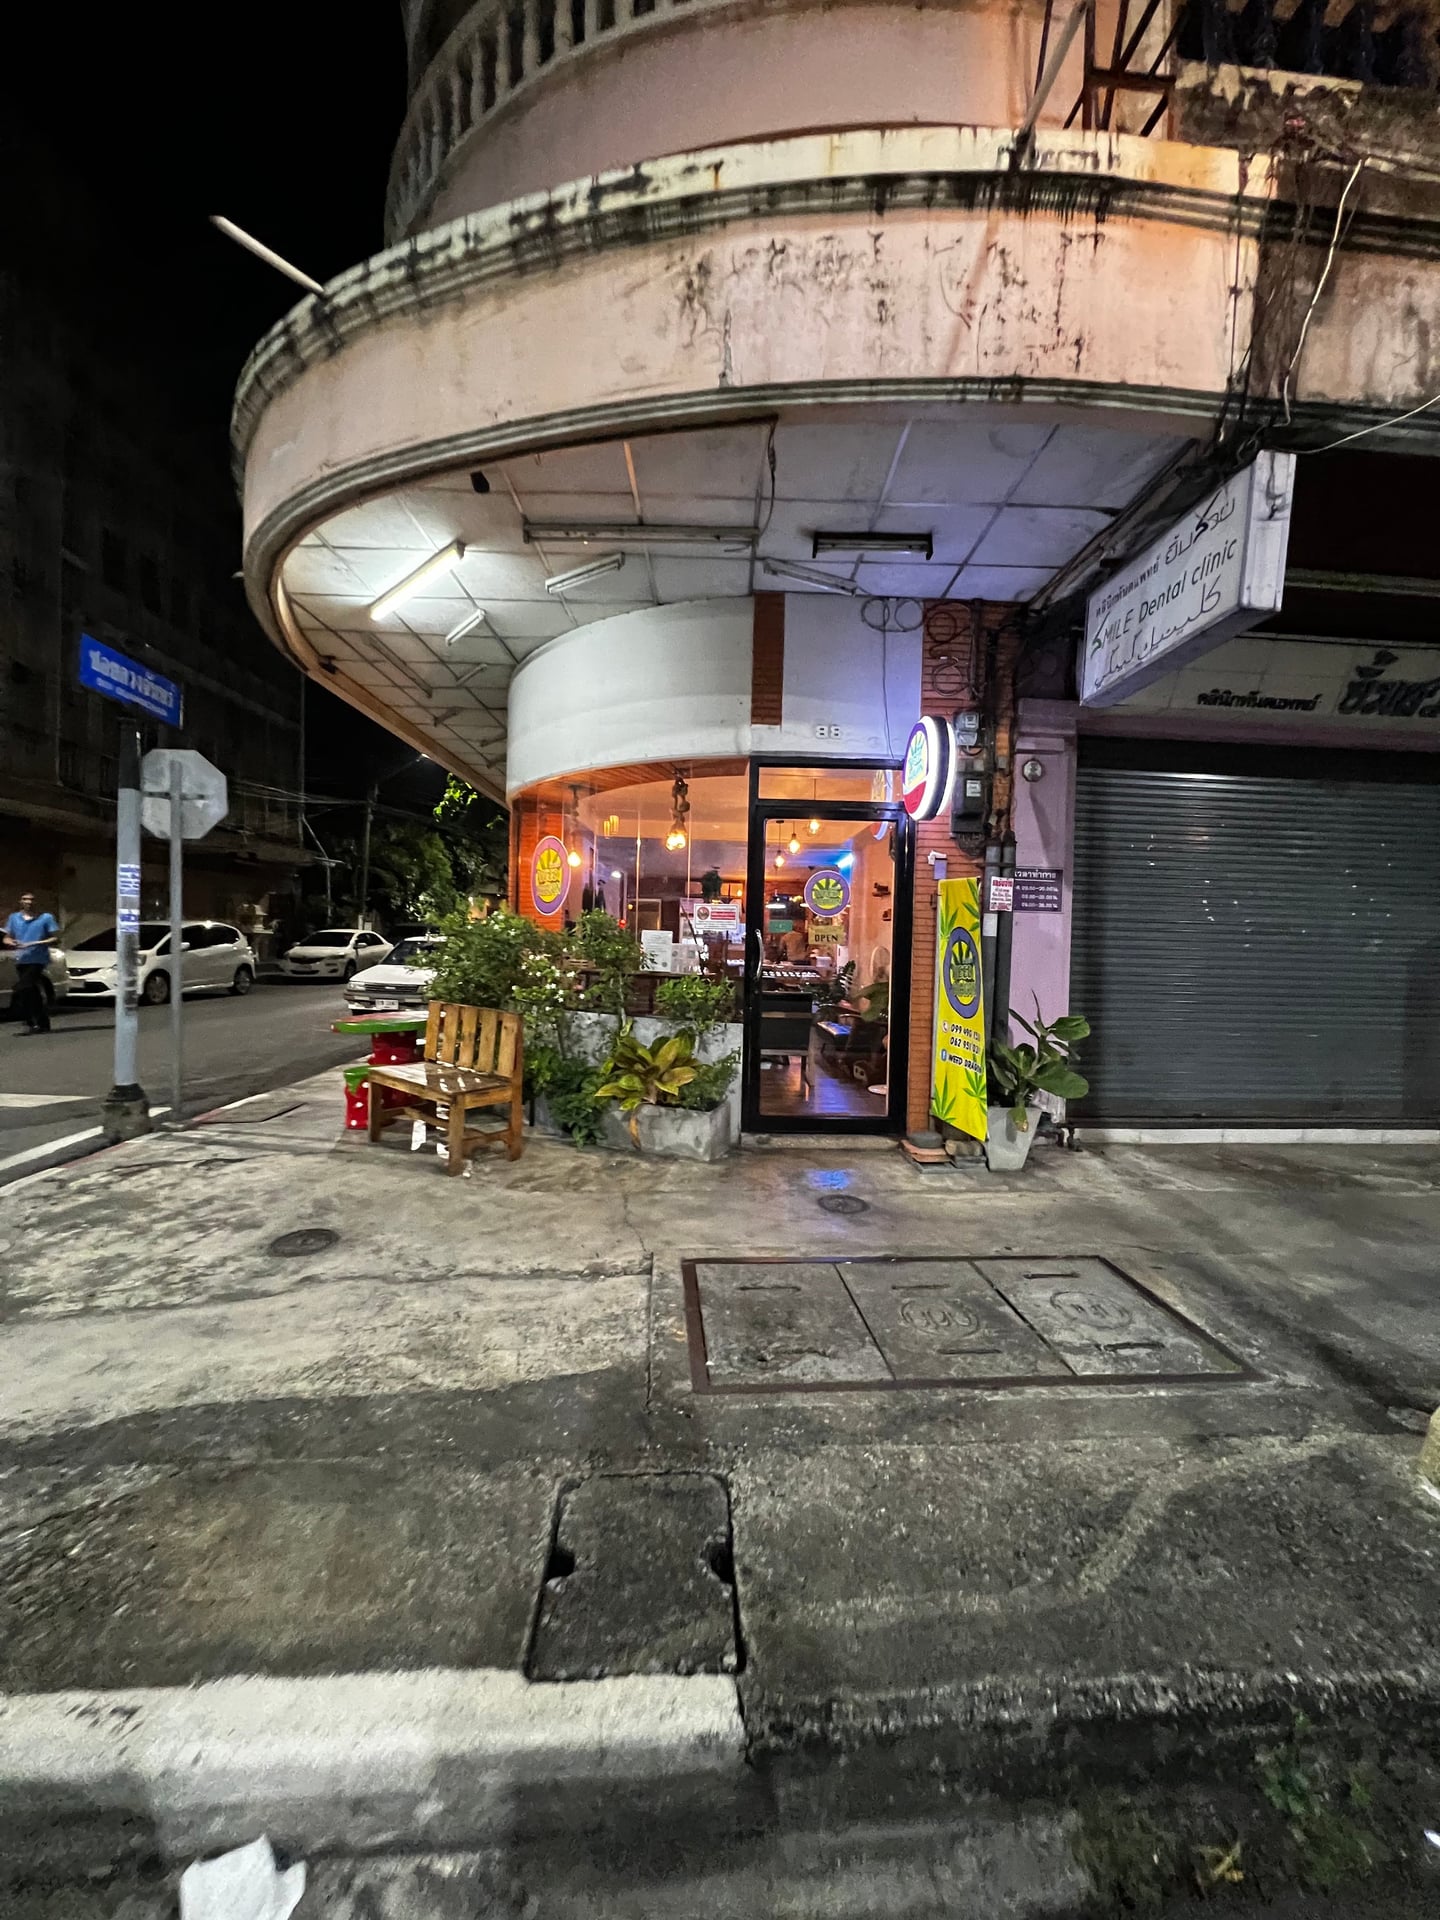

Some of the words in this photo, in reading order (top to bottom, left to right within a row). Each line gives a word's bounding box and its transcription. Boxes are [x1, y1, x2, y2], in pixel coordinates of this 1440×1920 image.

[1090, 608, 1135, 660] SMILE
[1138, 569, 1189, 623] Dental
[1191, 538, 1238, 587] clinic
[814, 934, 839, 942] OPEN
